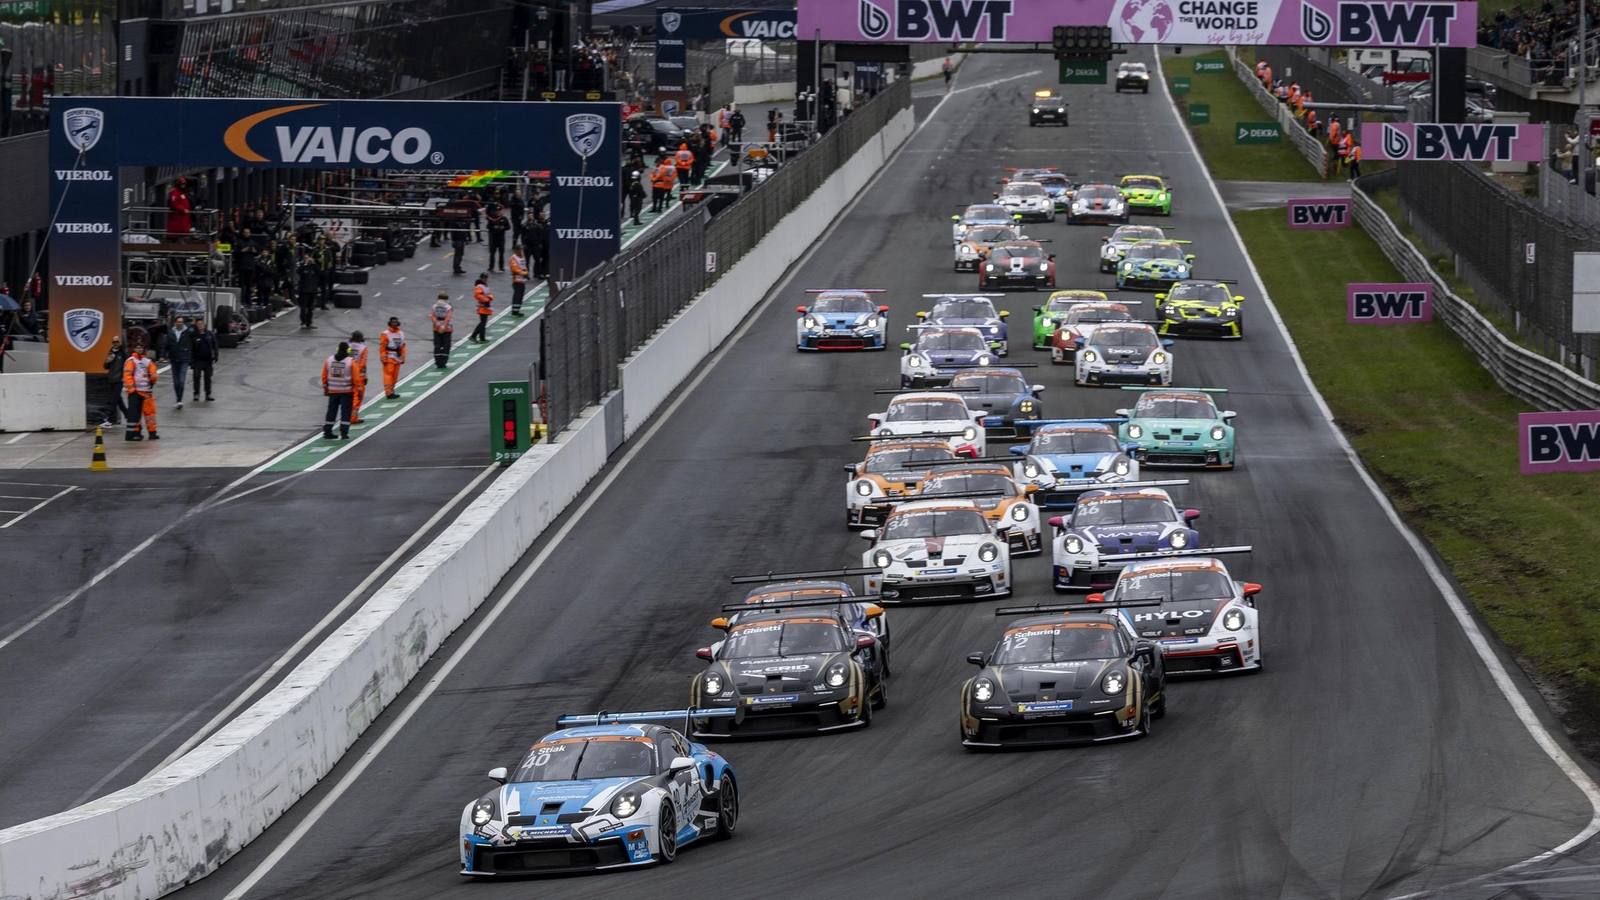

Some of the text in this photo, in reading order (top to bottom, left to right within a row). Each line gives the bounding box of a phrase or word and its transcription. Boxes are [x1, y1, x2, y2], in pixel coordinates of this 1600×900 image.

[1178, 1, 1258, 15] CHANGE
[896, 0, 1013, 41] BWT
[1195, 17, 1258, 30] WORLD
[1339, 2, 1454, 45] BWT
[741, 20, 797, 38] VAIC
[1250, 129, 1278, 137] DEKRA
[1415, 124, 1518, 160] BWT
[55, 170, 113, 181] VIEROL
[556, 176, 614, 187] VIEROL
[1293, 204, 1348, 224] BWT
[55, 223, 113, 233] VIEROL
[556, 229, 613, 239] VIEROL
[55, 275, 113, 286] VIEROL
[1354, 292, 1426, 319] BWT
[888, 519, 909, 531] 34
[1119, 580, 1141, 593] 14
[1135, 610, 1204, 622] HYLO
[743, 624, 781, 635] Ghiretti
[1014, 629, 1060, 640] Schuring
[1003, 638, 1029, 651] 12
[539, 745, 566, 755] Stiak
[521, 754, 551, 769] 40
